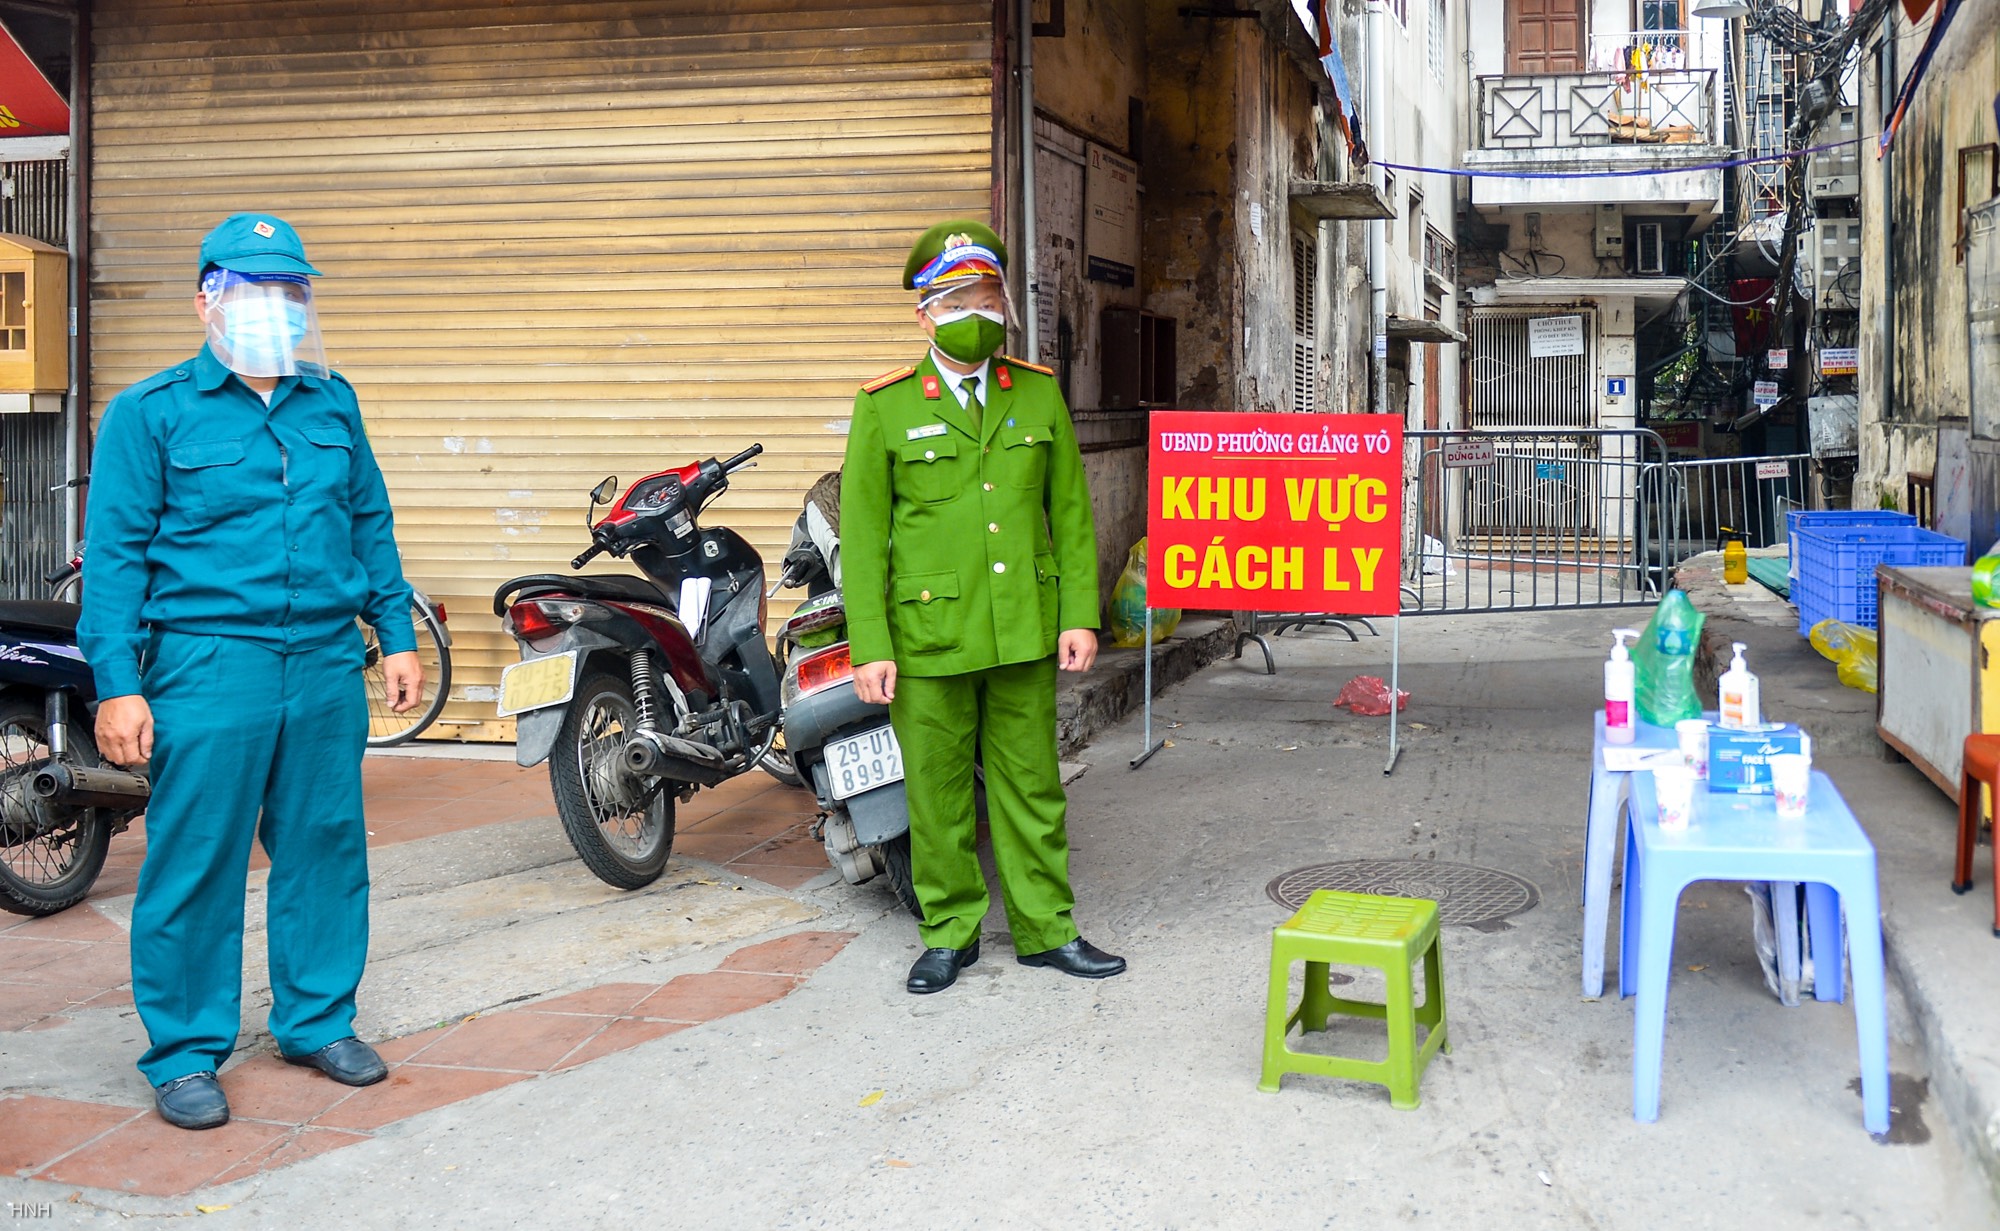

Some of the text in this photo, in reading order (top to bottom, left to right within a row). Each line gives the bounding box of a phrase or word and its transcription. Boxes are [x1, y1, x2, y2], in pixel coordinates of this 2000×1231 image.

[1612, 381, 1621, 393] 1
[1160, 425, 1391, 454] UBND PHƯỜNG GIẢNG VÕ
[1448, 450, 1491, 462] DỪNG LẠI
[1161, 473, 1388, 533] KHU VỰC
[1163, 535, 1385, 592] CÁCH LY
[836, 728, 895, 768] 29-U1
[1742, 754, 1765, 765] FACE
[842, 753, 901, 792] 8992
